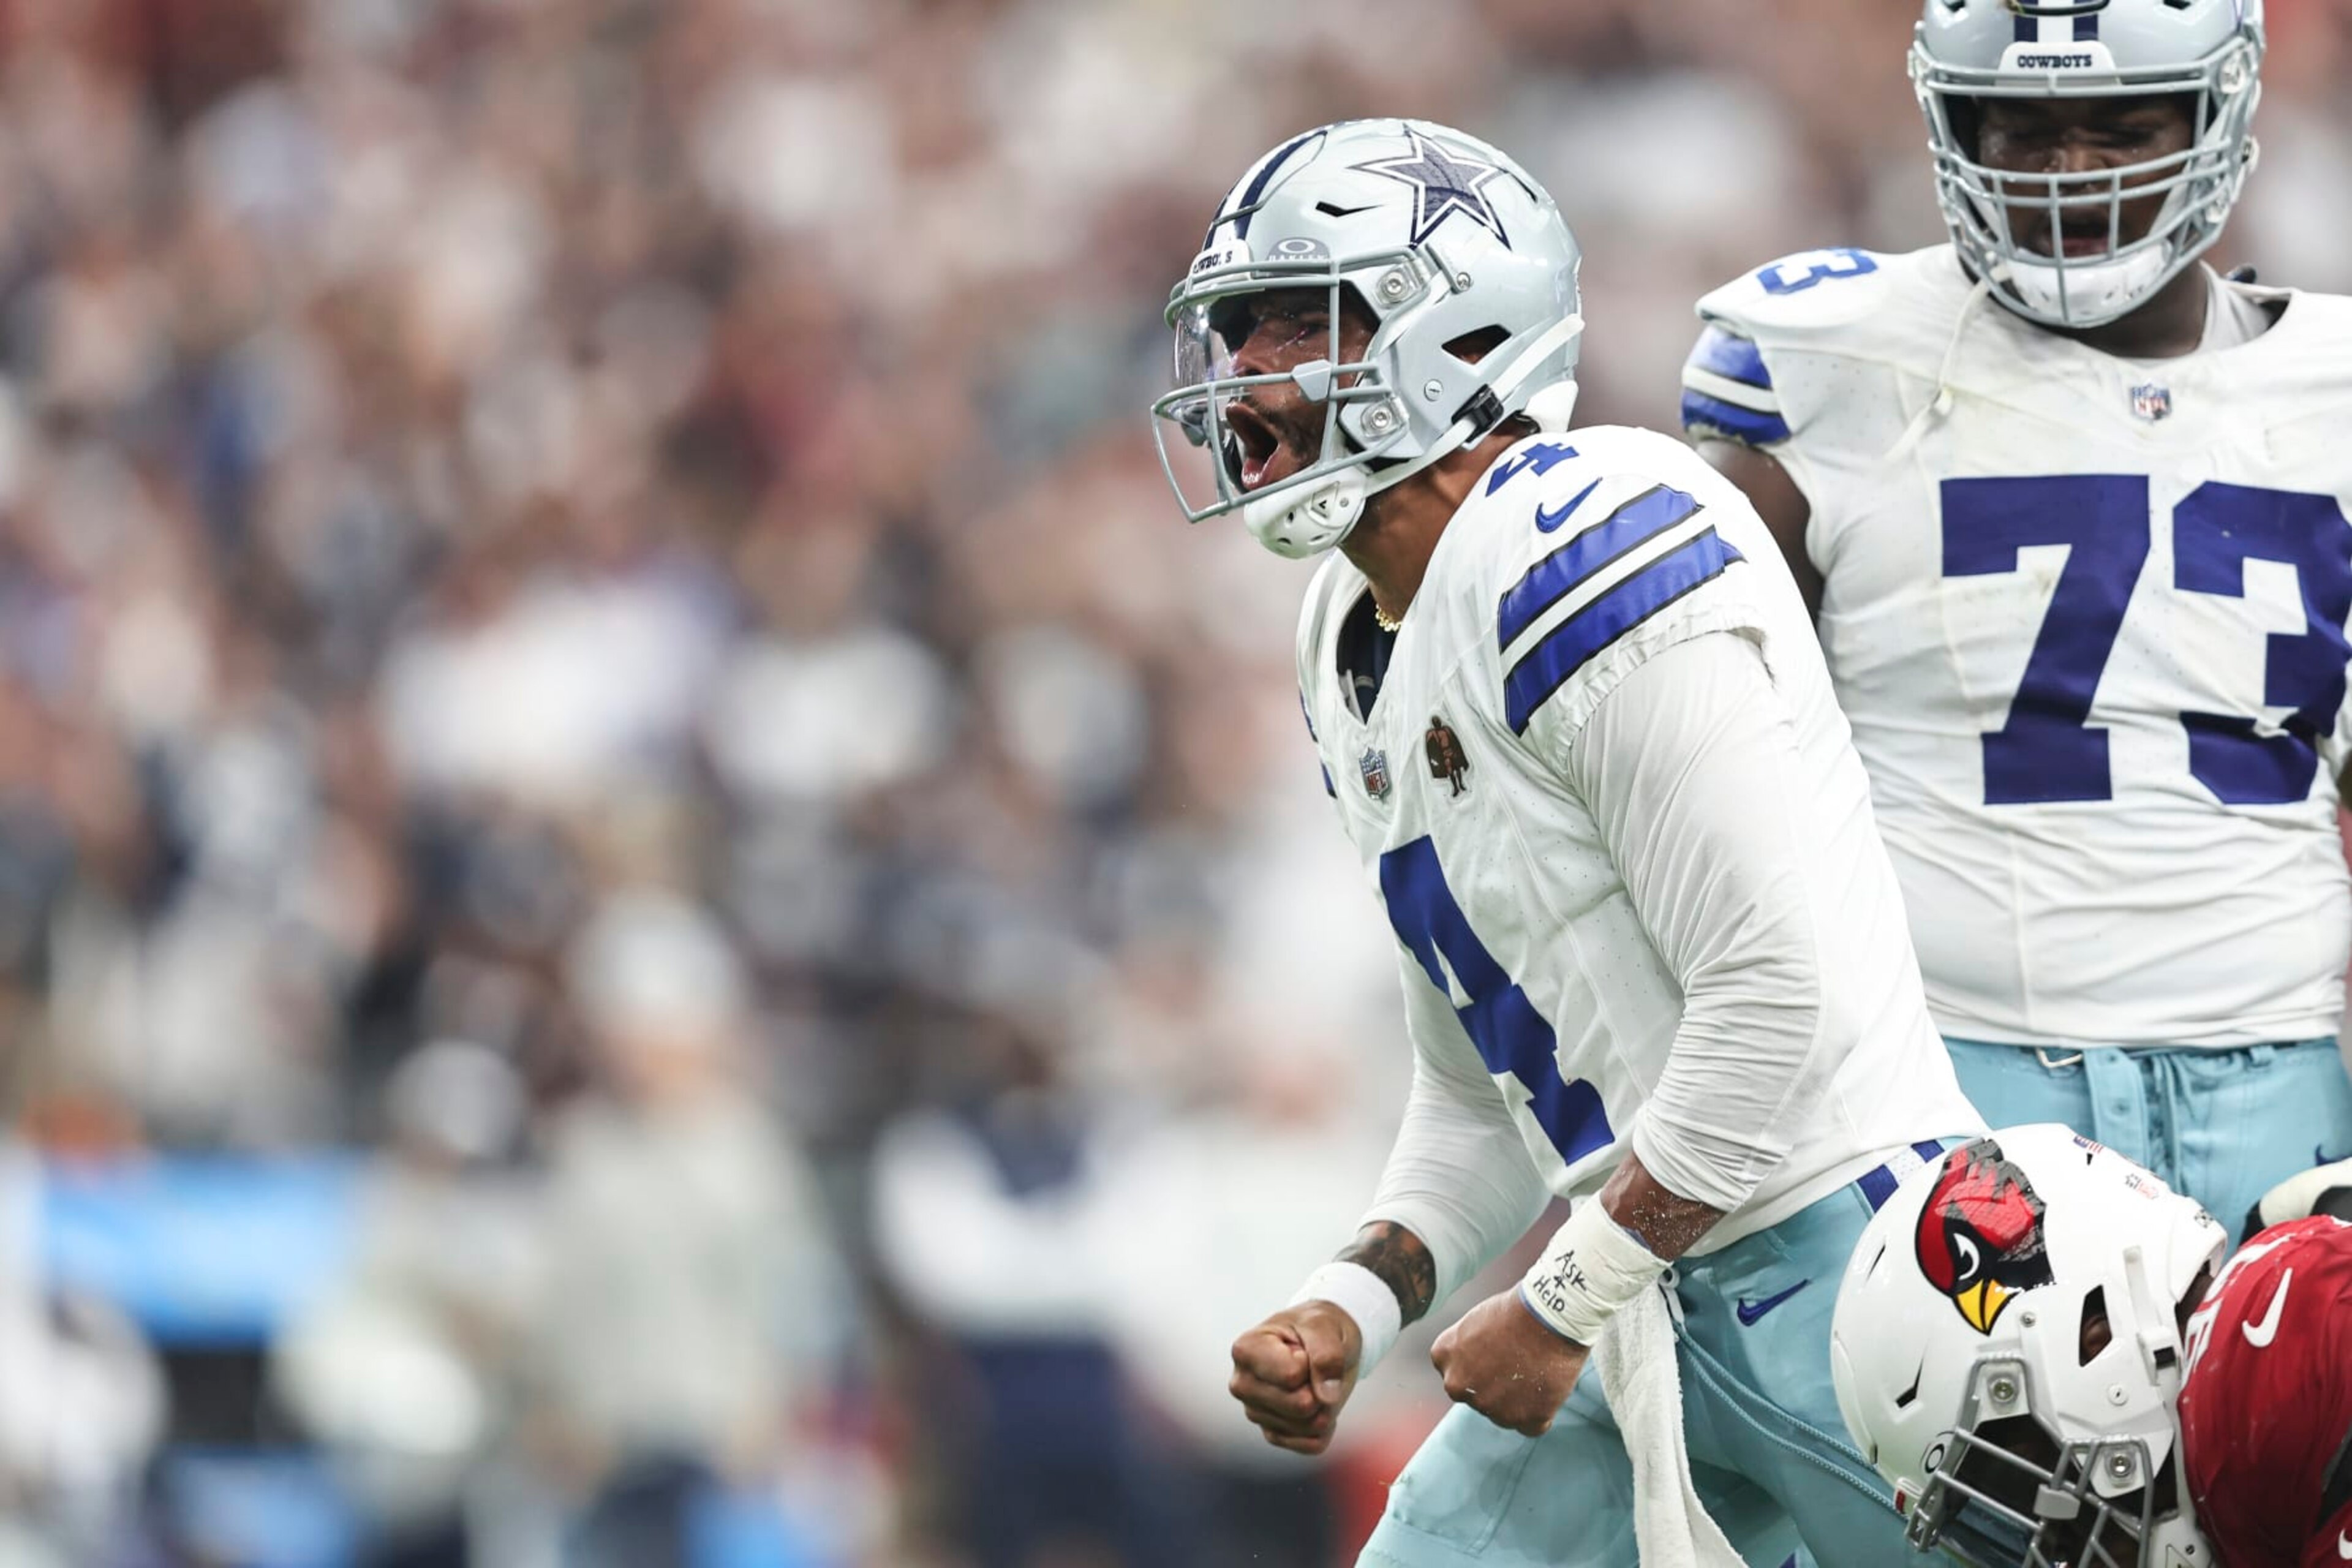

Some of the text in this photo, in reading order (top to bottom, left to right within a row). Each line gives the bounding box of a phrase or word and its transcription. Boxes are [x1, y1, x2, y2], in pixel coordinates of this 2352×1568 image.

[2017, 55, 2092, 68] COWBOYS
[1485, 442, 1580, 498] 4
[1939, 473, 2352, 805] 73
[1379, 834, 1616, 1167] 4
